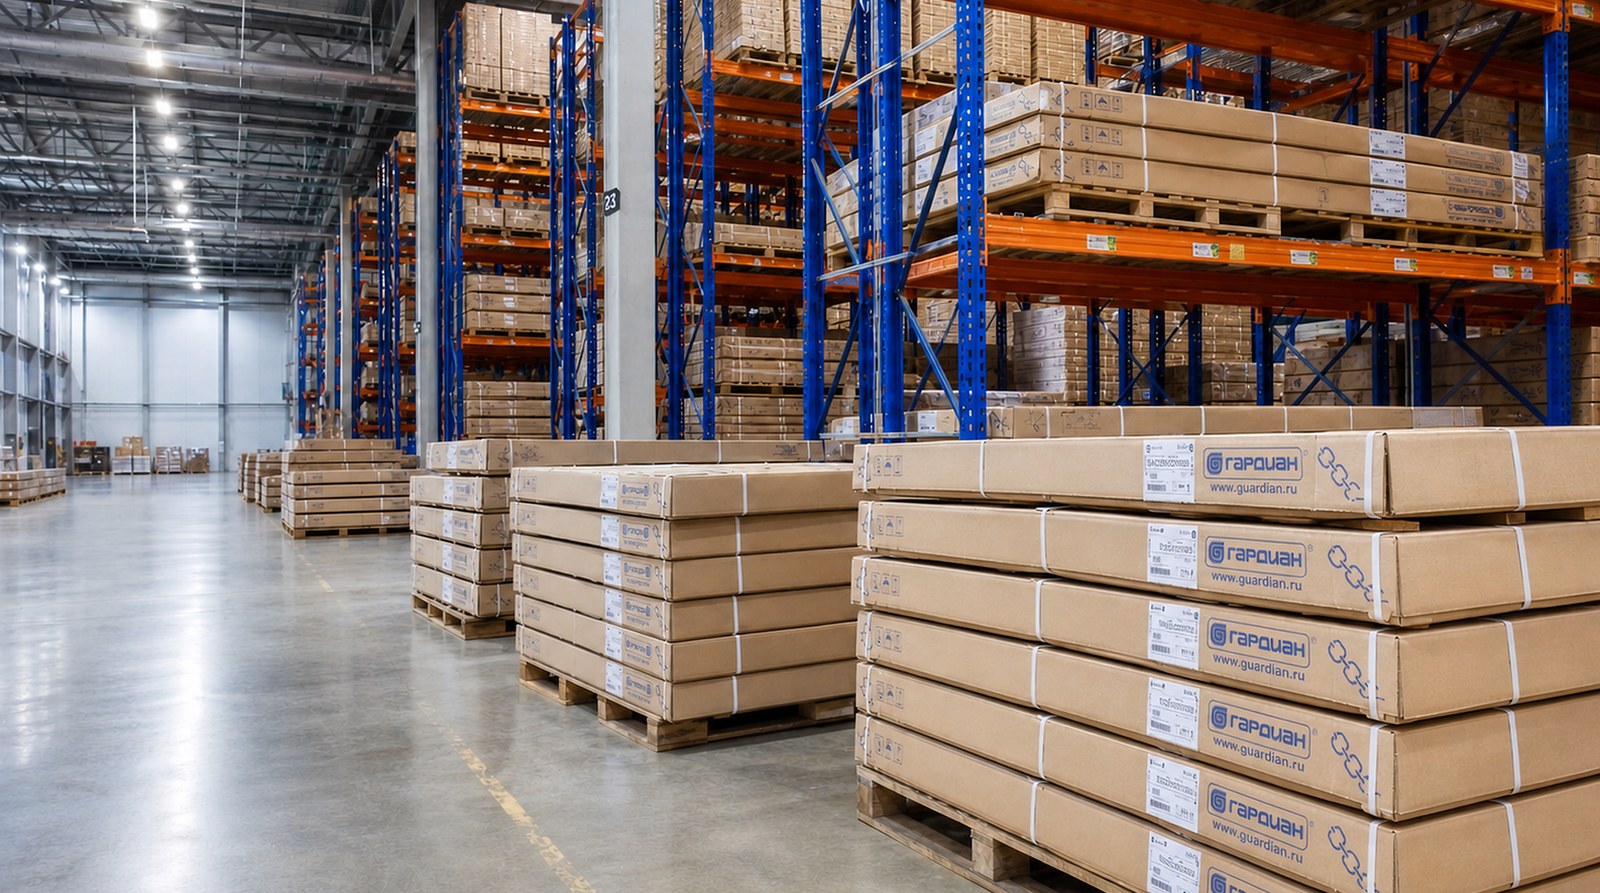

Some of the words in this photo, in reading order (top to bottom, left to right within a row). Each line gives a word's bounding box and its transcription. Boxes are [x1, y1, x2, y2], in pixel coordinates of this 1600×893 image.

[604, 192, 617, 211] 23
[1210, 482, 1298, 495] www.guardian.ru
[1211, 572, 1302, 591] www.guardian.ru
[1213, 654, 1305, 681] www.guardian.ru
[1213, 737, 1305, 772] www.guardian.ru
[1212, 820, 1304, 864] www.guardian.ru
